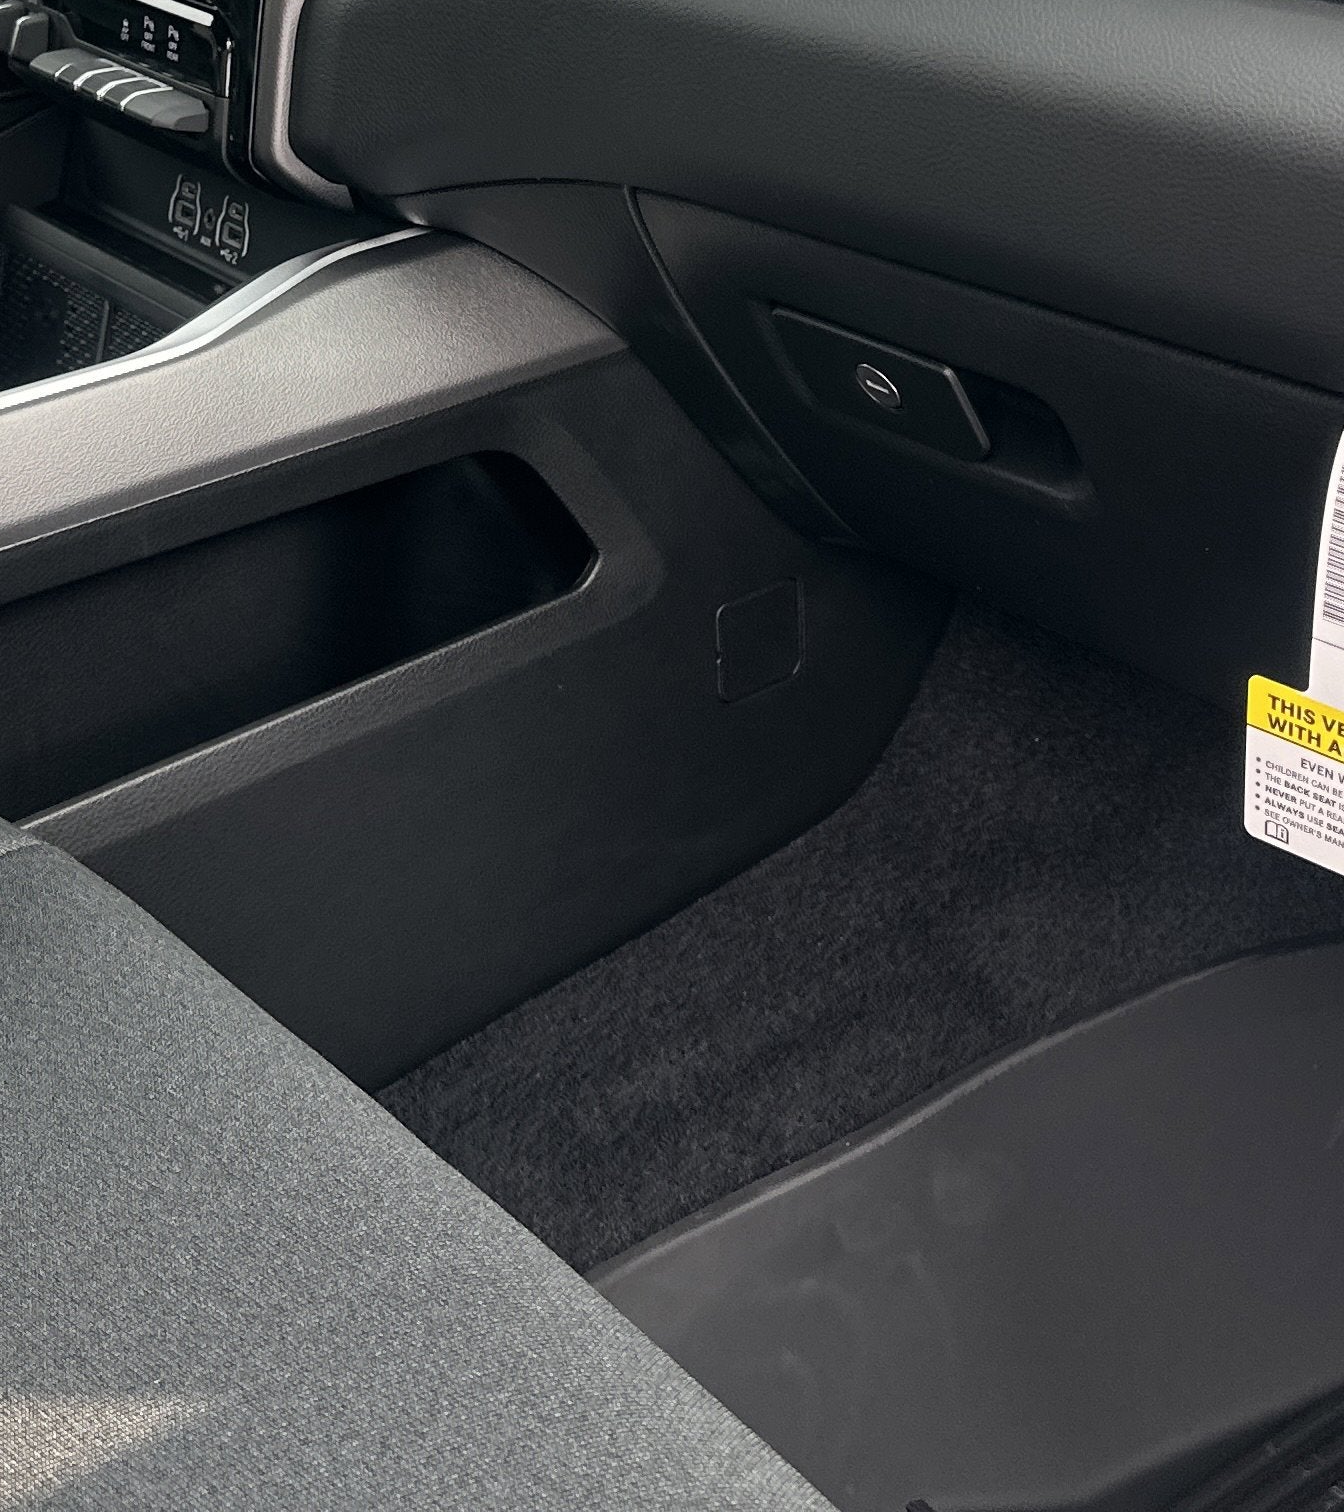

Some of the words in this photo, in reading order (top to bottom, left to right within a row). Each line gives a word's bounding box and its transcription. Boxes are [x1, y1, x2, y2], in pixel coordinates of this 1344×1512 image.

[1268, 693, 1315, 726] THIS
[1267, 713, 1321, 748] WITH
[1265, 759, 1308, 785] CHILDREN
[1311, 778, 1329, 793] CAN
[1332, 787, 1342, 799] BE
[1300, 757, 1333, 781] EVEN
[1265, 771, 1281, 786] THE
[1284, 779, 1309, 797] BACK
[1312, 791, 1336, 808] SEAT
[1264, 796, 1304, 820] ALWAYS
[1306, 813, 1323, 828] USE
